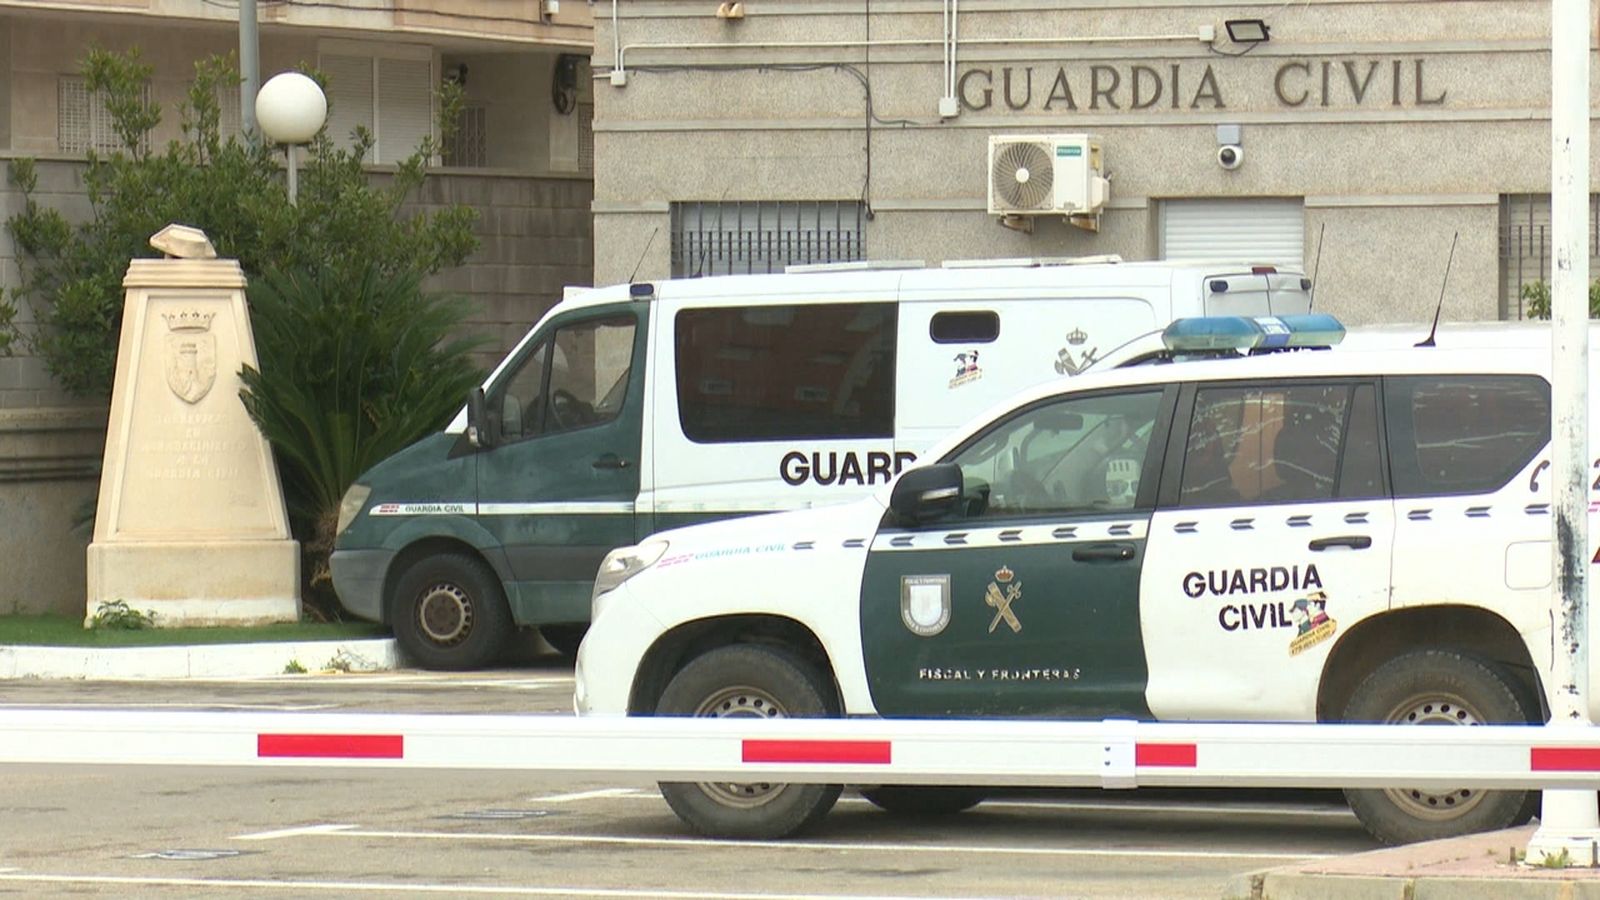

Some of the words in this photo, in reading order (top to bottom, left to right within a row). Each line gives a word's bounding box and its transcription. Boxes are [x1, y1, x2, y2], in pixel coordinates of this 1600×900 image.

[957, 63, 1226, 111] GUARDIA
[1274, 59, 1447, 108] CIVIL
[779, 450, 918, 486] GUARD
[405, 505, 442, 513] GUARDIA
[444, 505, 464, 513] CIVIL
[1182, 563, 1323, 598] GUARDIA
[1218, 602, 1292, 631] CIVIL
[919, 668, 971, 680] FISCAL
[977, 669, 985, 679] Y
[992, 668, 1081, 680] FRONTERAS
